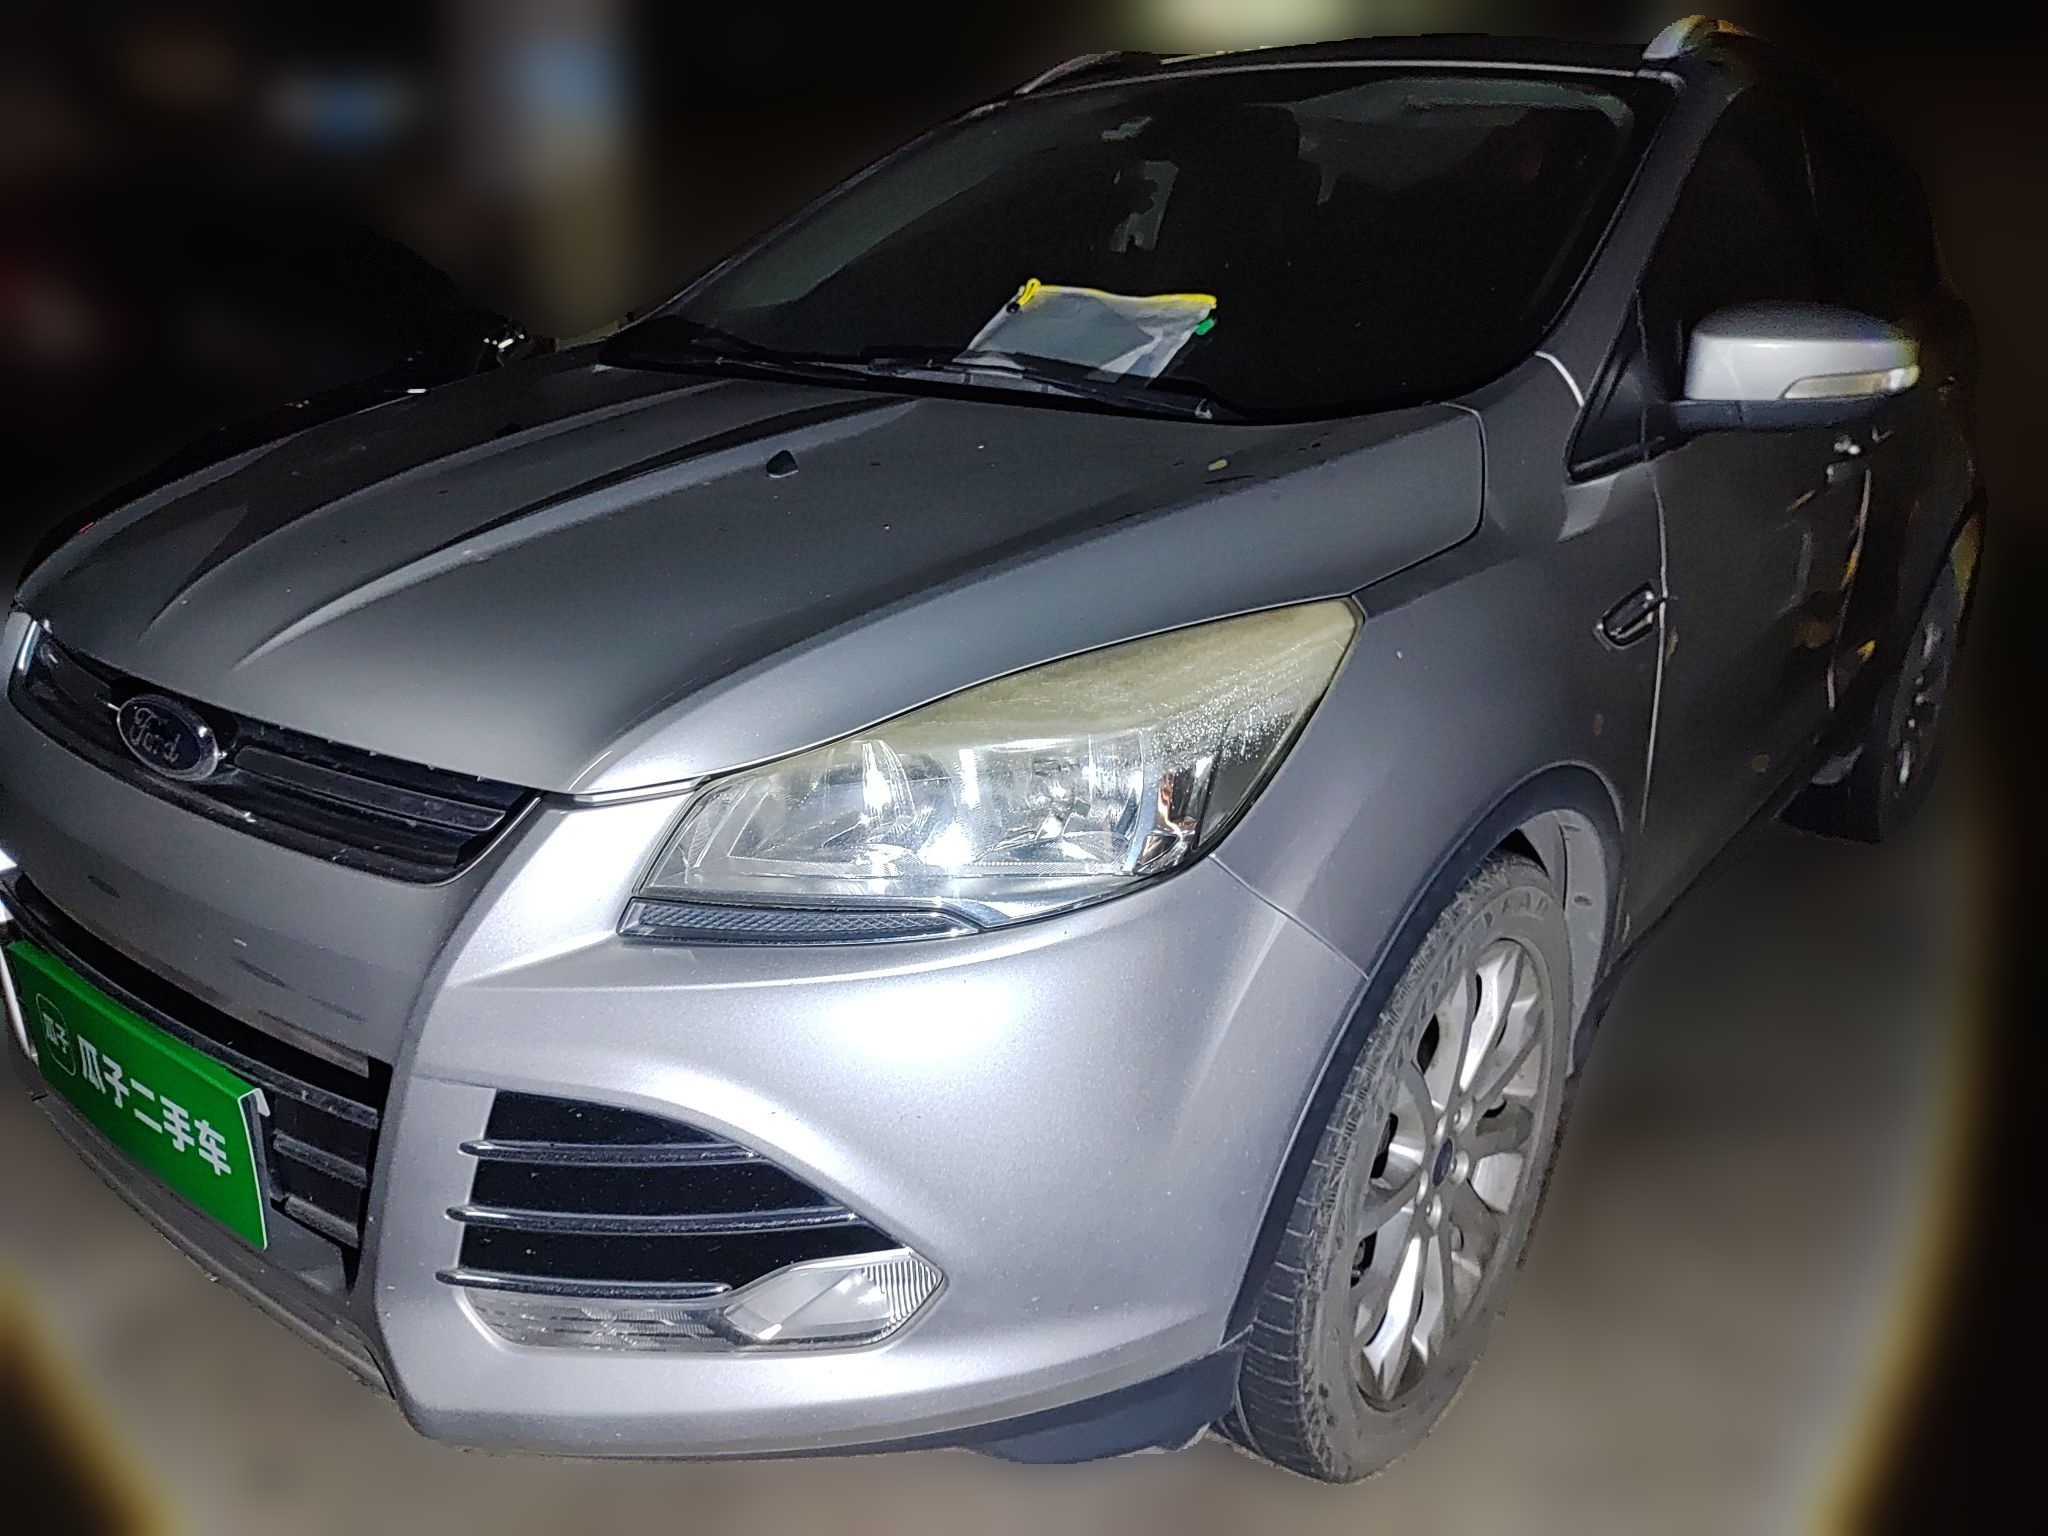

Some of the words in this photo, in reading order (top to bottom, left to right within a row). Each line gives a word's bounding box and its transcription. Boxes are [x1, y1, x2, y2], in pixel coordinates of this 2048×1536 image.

[129, 707, 181, 763] Ford
[76, 1033, 231, 1176] 瓜子二手车
